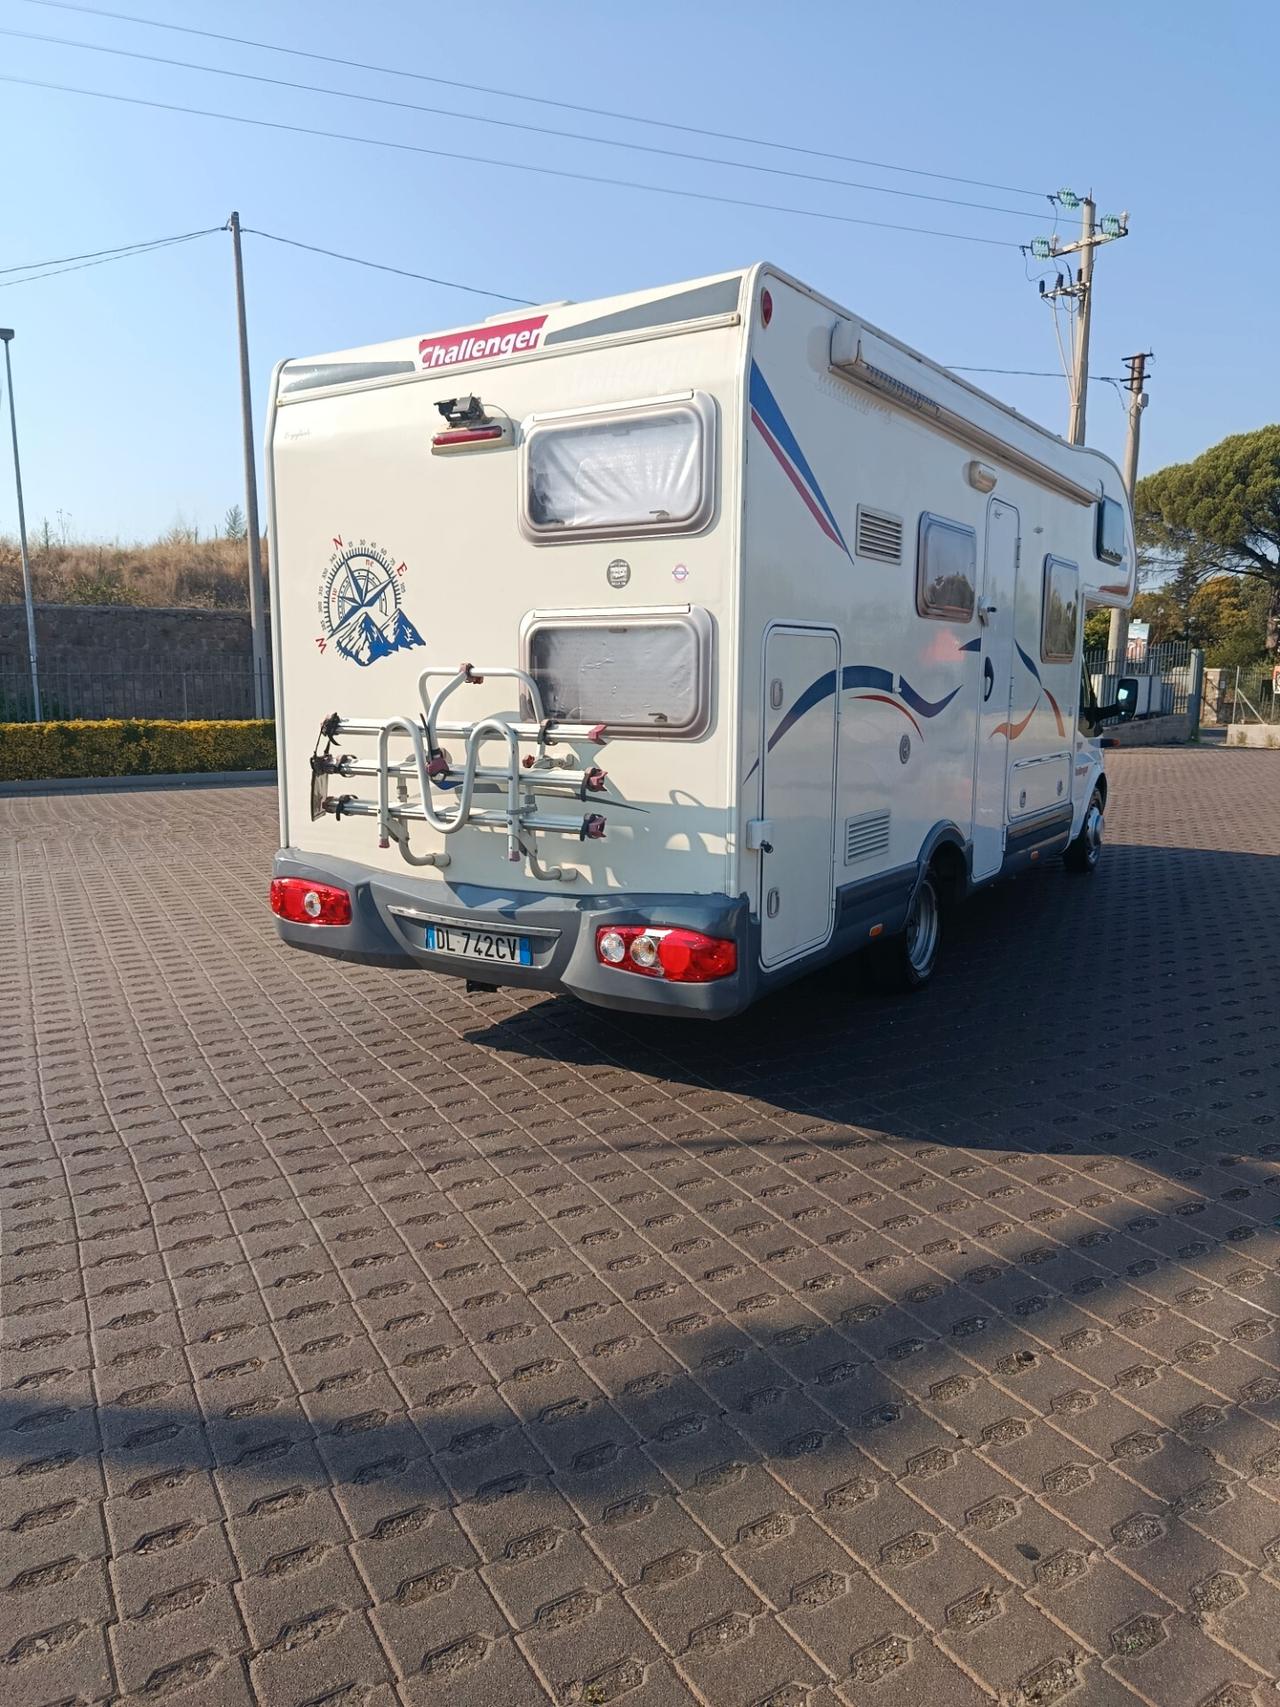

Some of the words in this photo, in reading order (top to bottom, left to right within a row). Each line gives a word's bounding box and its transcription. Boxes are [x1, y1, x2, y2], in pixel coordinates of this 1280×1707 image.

[419, 327, 543, 368] Challenger
[333, 534, 343, 550] N
[396, 561, 408, 577] E
[315, 638, 327, 654] W
[436, 927, 456, 952] DL
[461, 932, 517, 961] 742CV
